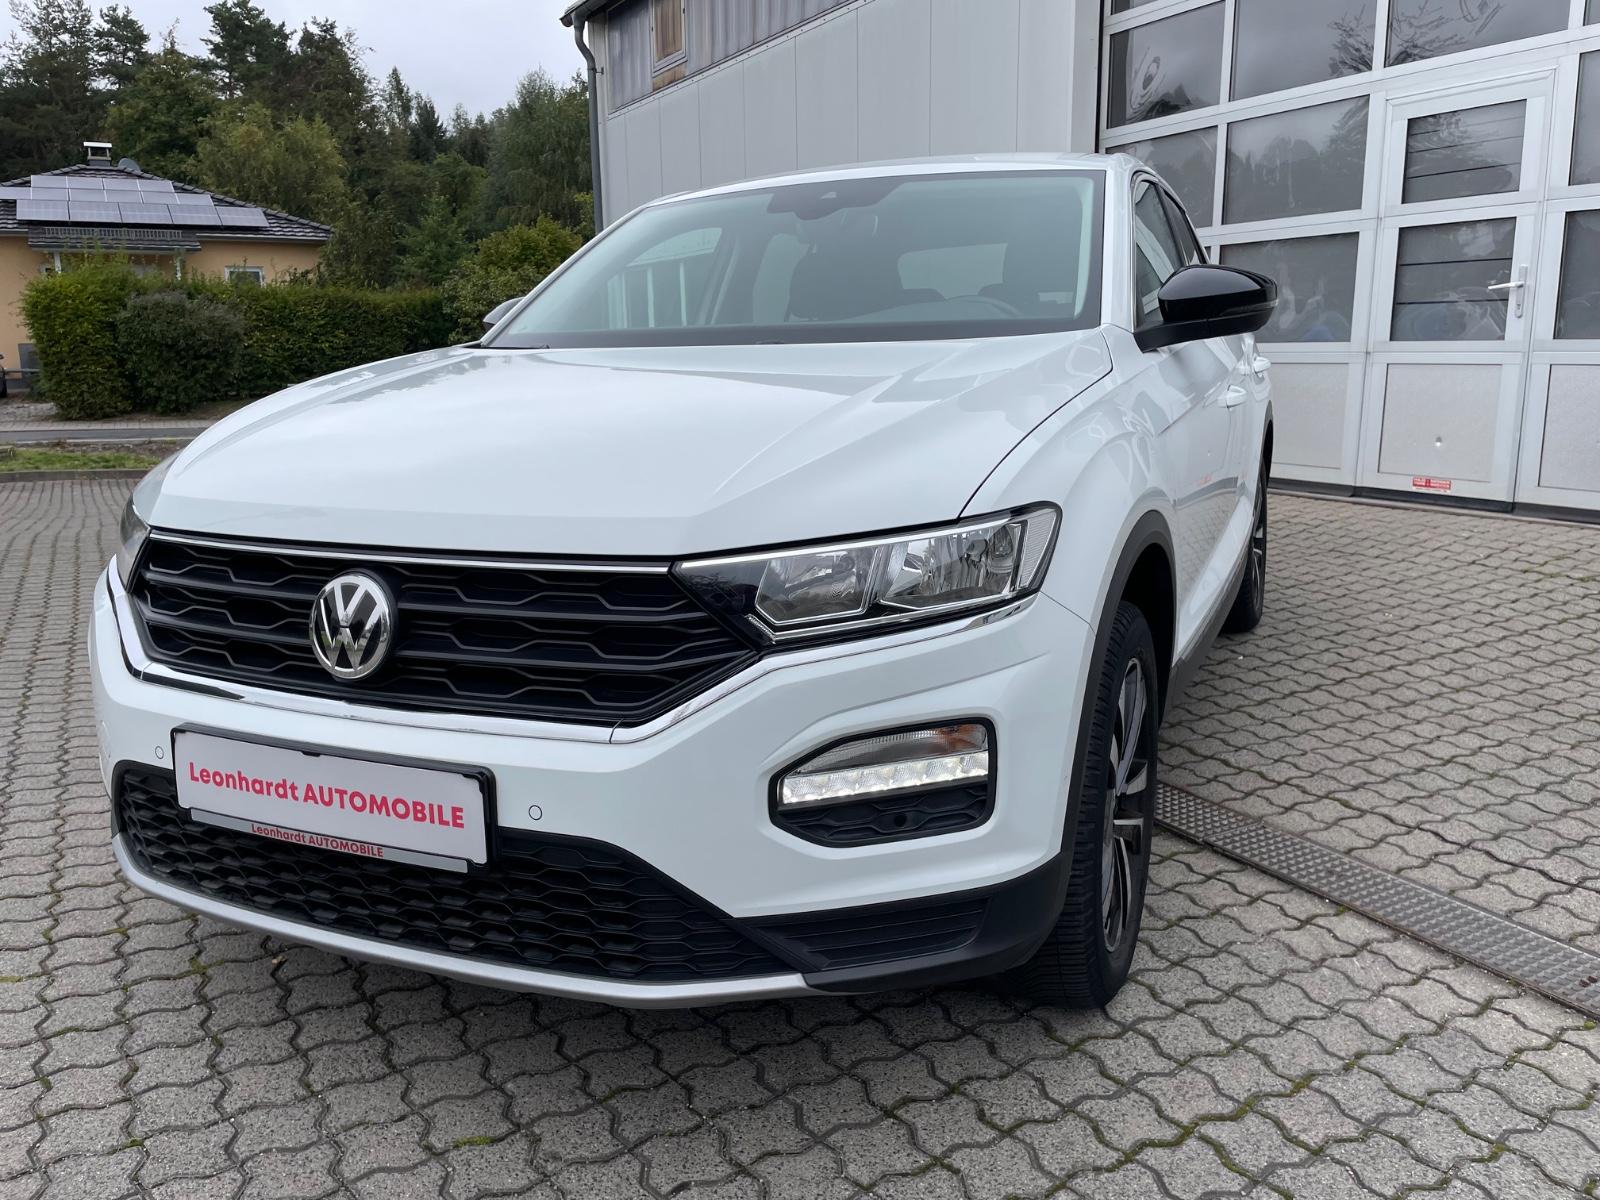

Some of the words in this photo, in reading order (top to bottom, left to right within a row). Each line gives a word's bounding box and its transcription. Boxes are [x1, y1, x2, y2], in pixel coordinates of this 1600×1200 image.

[189, 761, 299, 802] Leonhardt
[303, 783, 465, 829] AUTOMOBILE
[251, 823, 306, 844] Leonhardt
[309, 835, 384, 858] AUTOMOBILE
